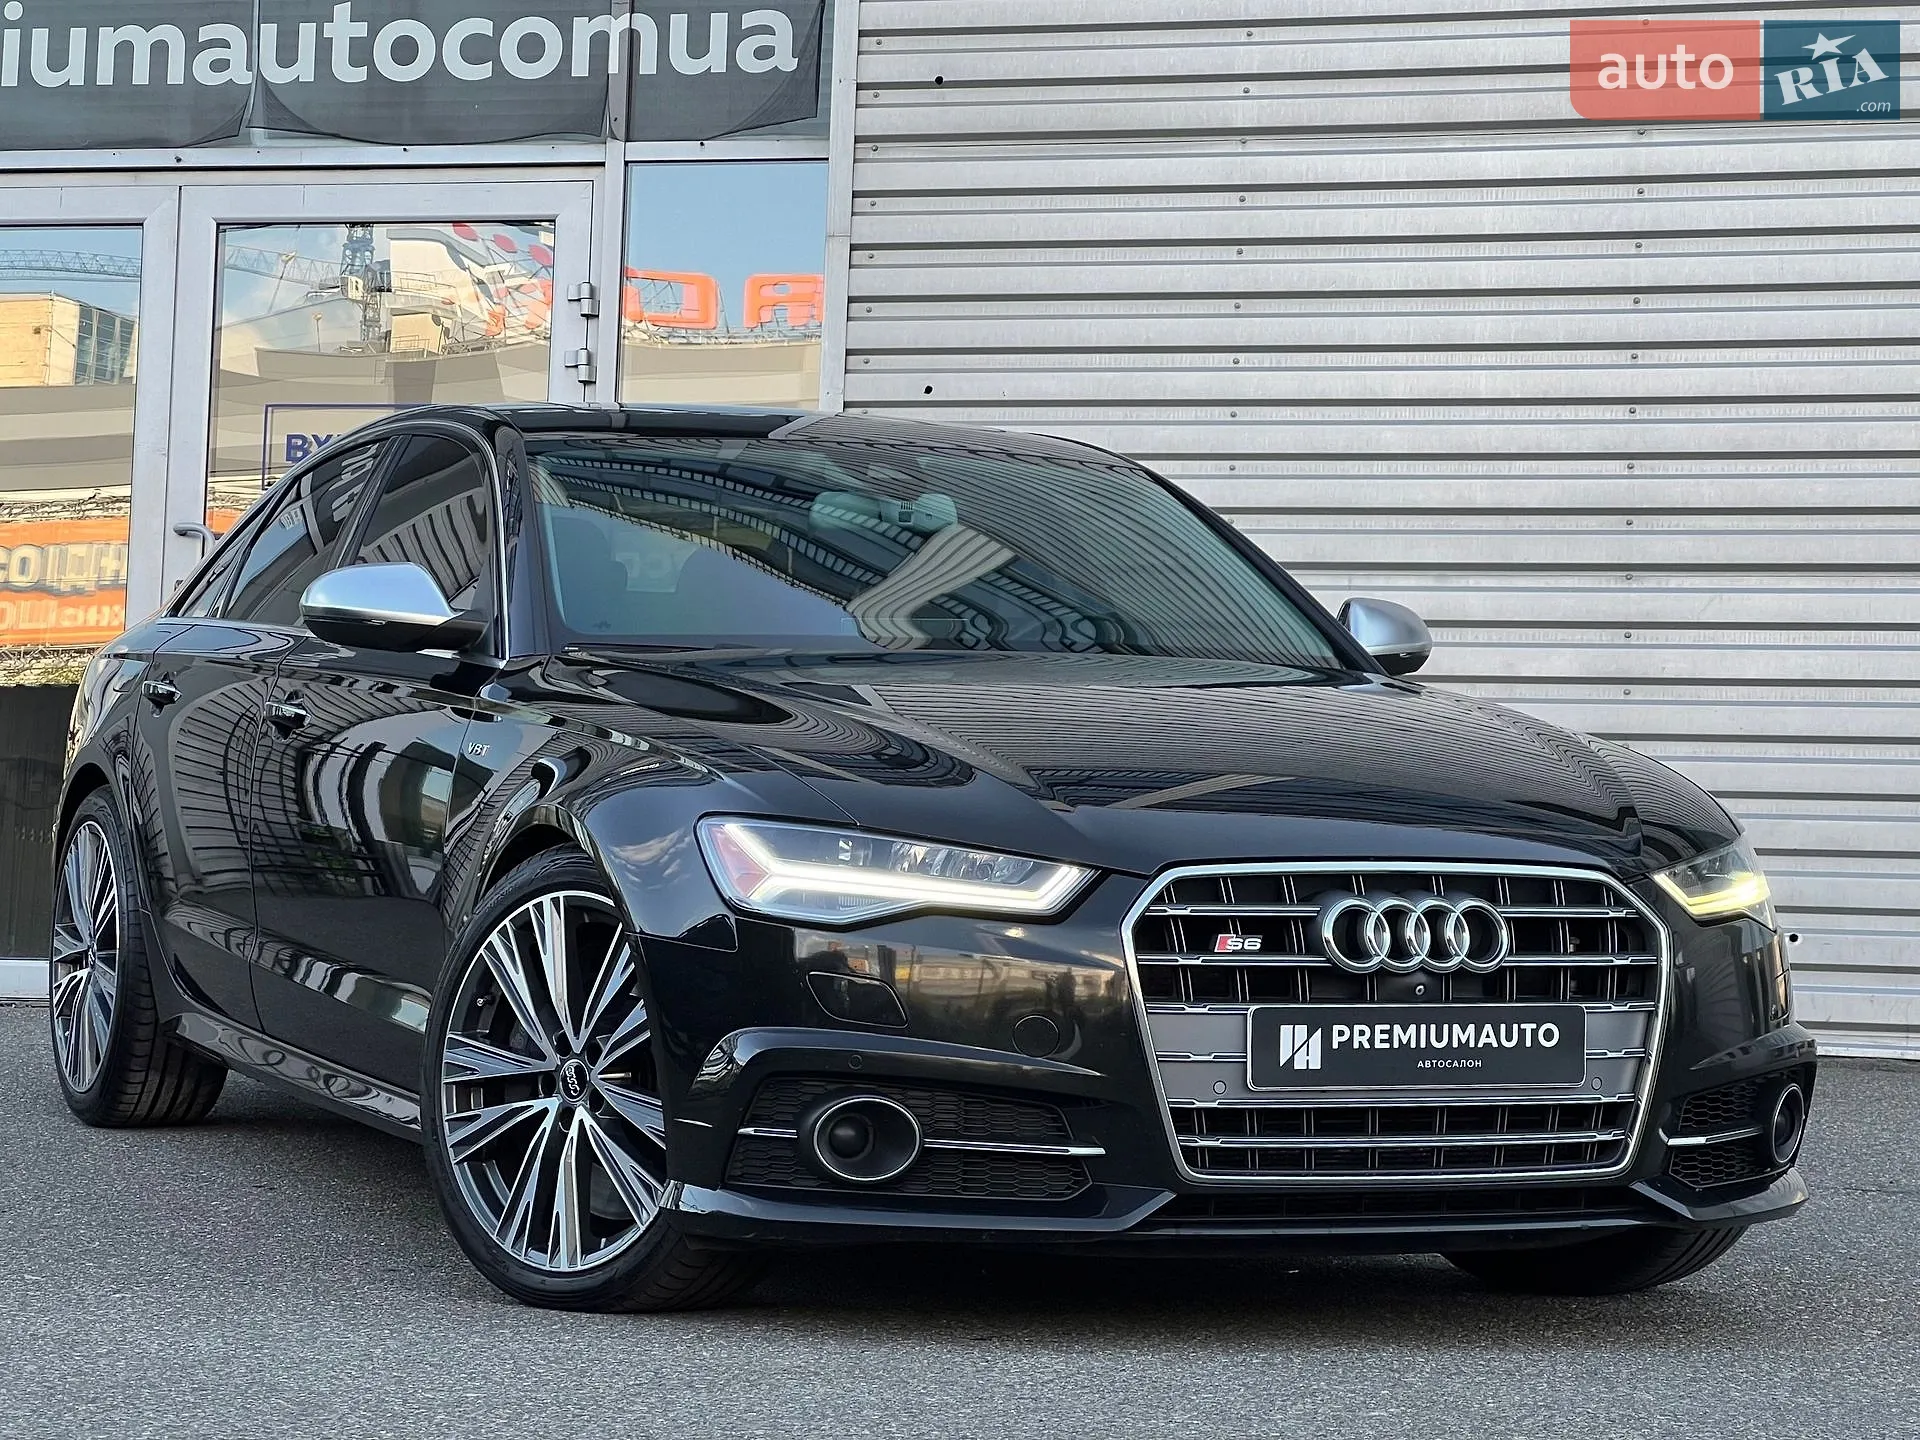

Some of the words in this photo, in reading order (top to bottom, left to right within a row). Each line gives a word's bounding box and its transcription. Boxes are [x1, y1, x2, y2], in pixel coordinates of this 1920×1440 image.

[1, 1, 799, 88] iumautocomua
[1223, 936, 1262, 951] S6
[1332, 1023, 1560, 1049] PREMIUMAUTO
[1416, 1058, 1483, 1069] АВТОСАЛОН
